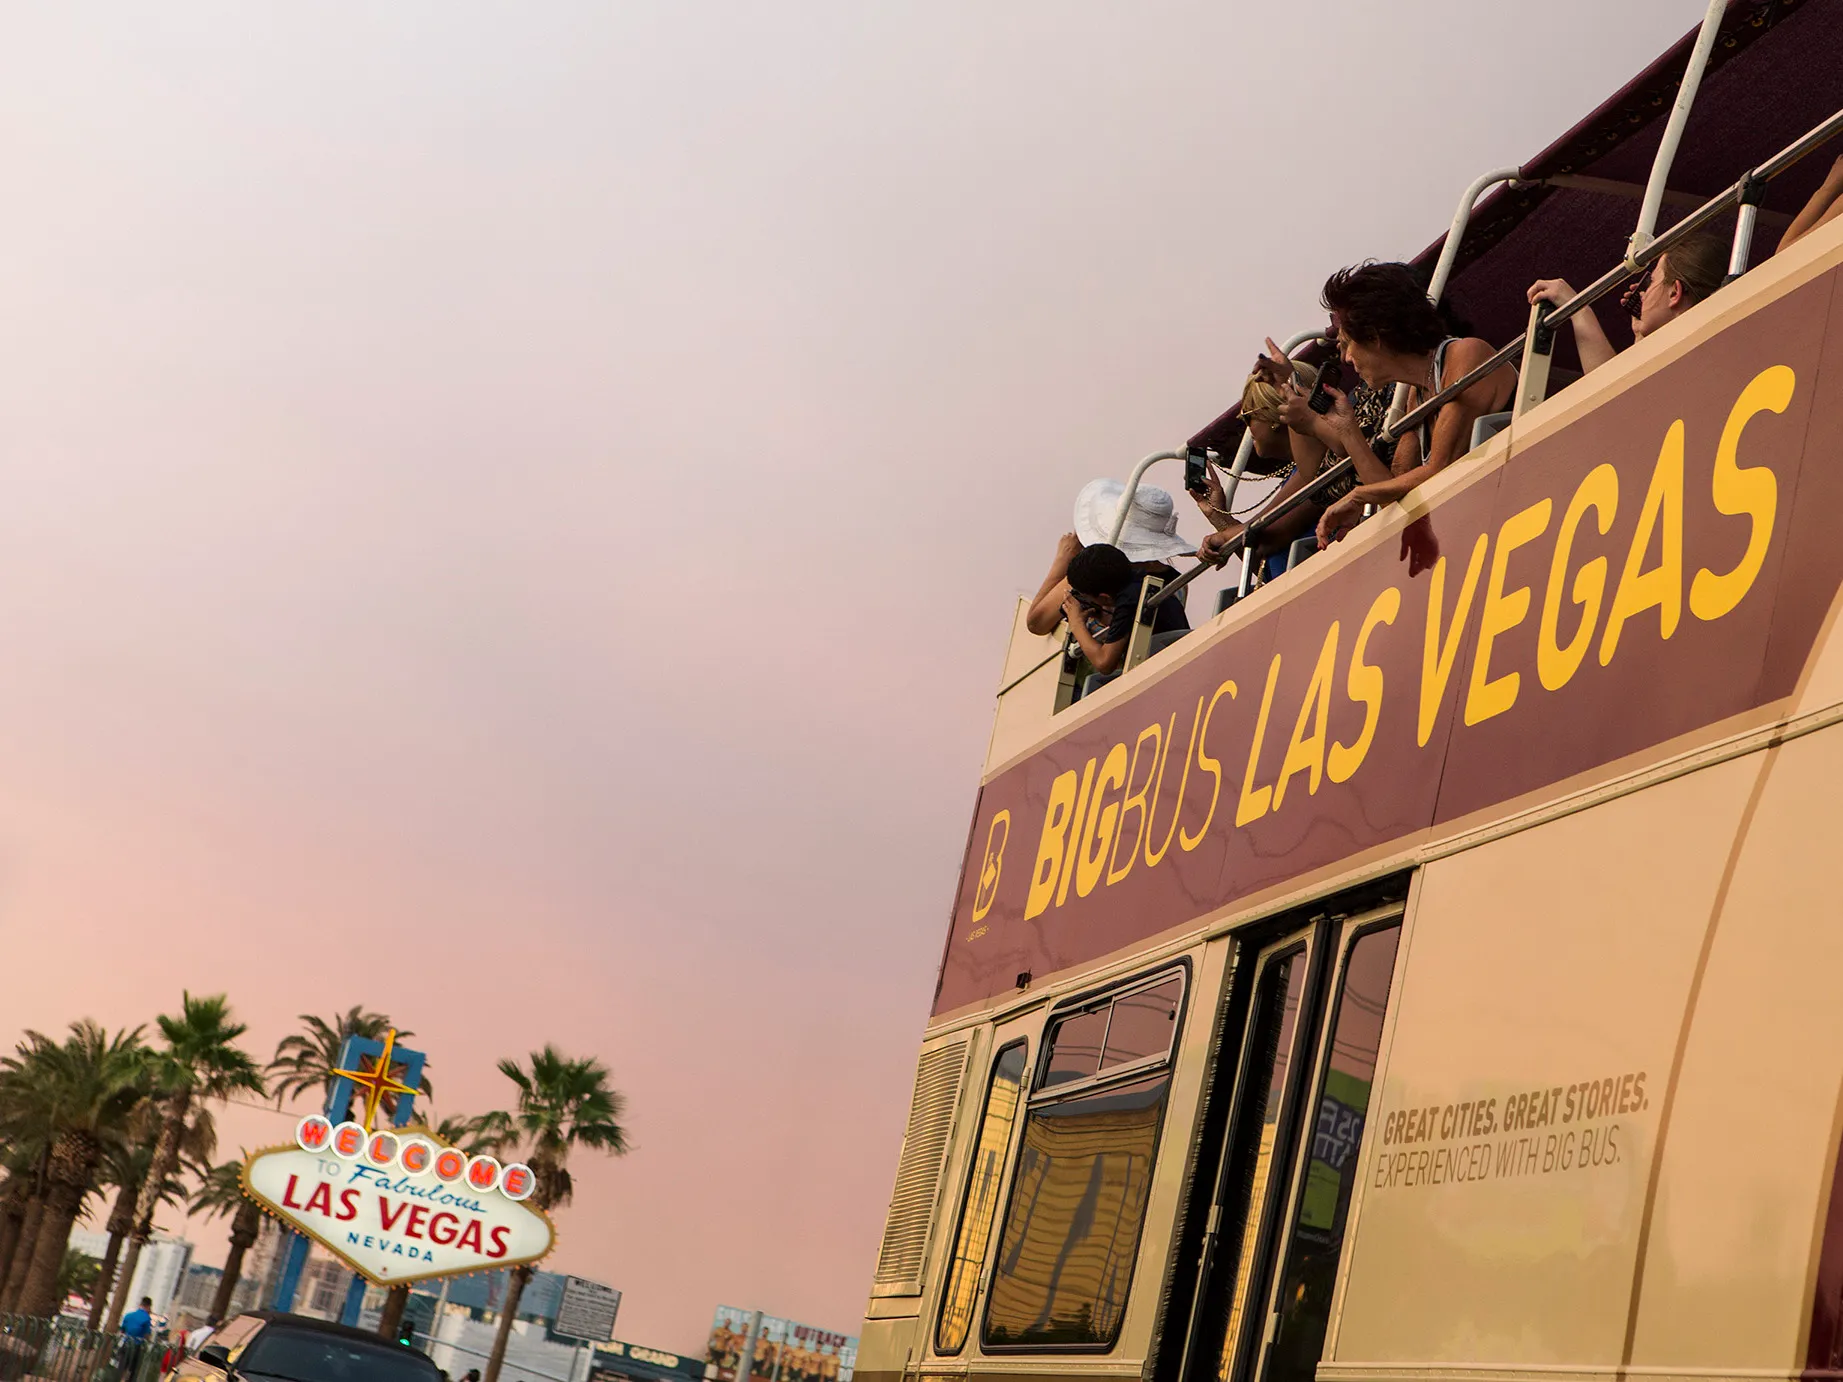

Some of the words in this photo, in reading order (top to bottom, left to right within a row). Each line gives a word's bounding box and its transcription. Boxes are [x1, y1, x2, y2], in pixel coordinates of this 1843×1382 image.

[1236, 587, 1401, 827] LAS
[1417, 364, 1796, 747] VEGAS
[1383, 1106, 1439, 1145] GREAT
[1440, 1098, 1498, 1141] CITIES.
[1503, 1087, 1563, 1132] GREAT
[1562, 1071, 1648, 1124] STORIES.
[302, 1120, 528, 1194] WELCOME
[316, 1158, 341, 1177] TO
[348, 1163, 487, 1214] Fabulous
[1374, 1143, 1492, 1188] EXPERIENCED
[1495, 1136, 1538, 1178] WITH
[1542, 1130, 1575, 1173] BIG
[1578, 1124, 1621, 1169] BUS.
[282, 1174, 361, 1222] LAS
[378, 1195, 511, 1259] VEGAS
[347, 1231, 434, 1264] NEVADA
